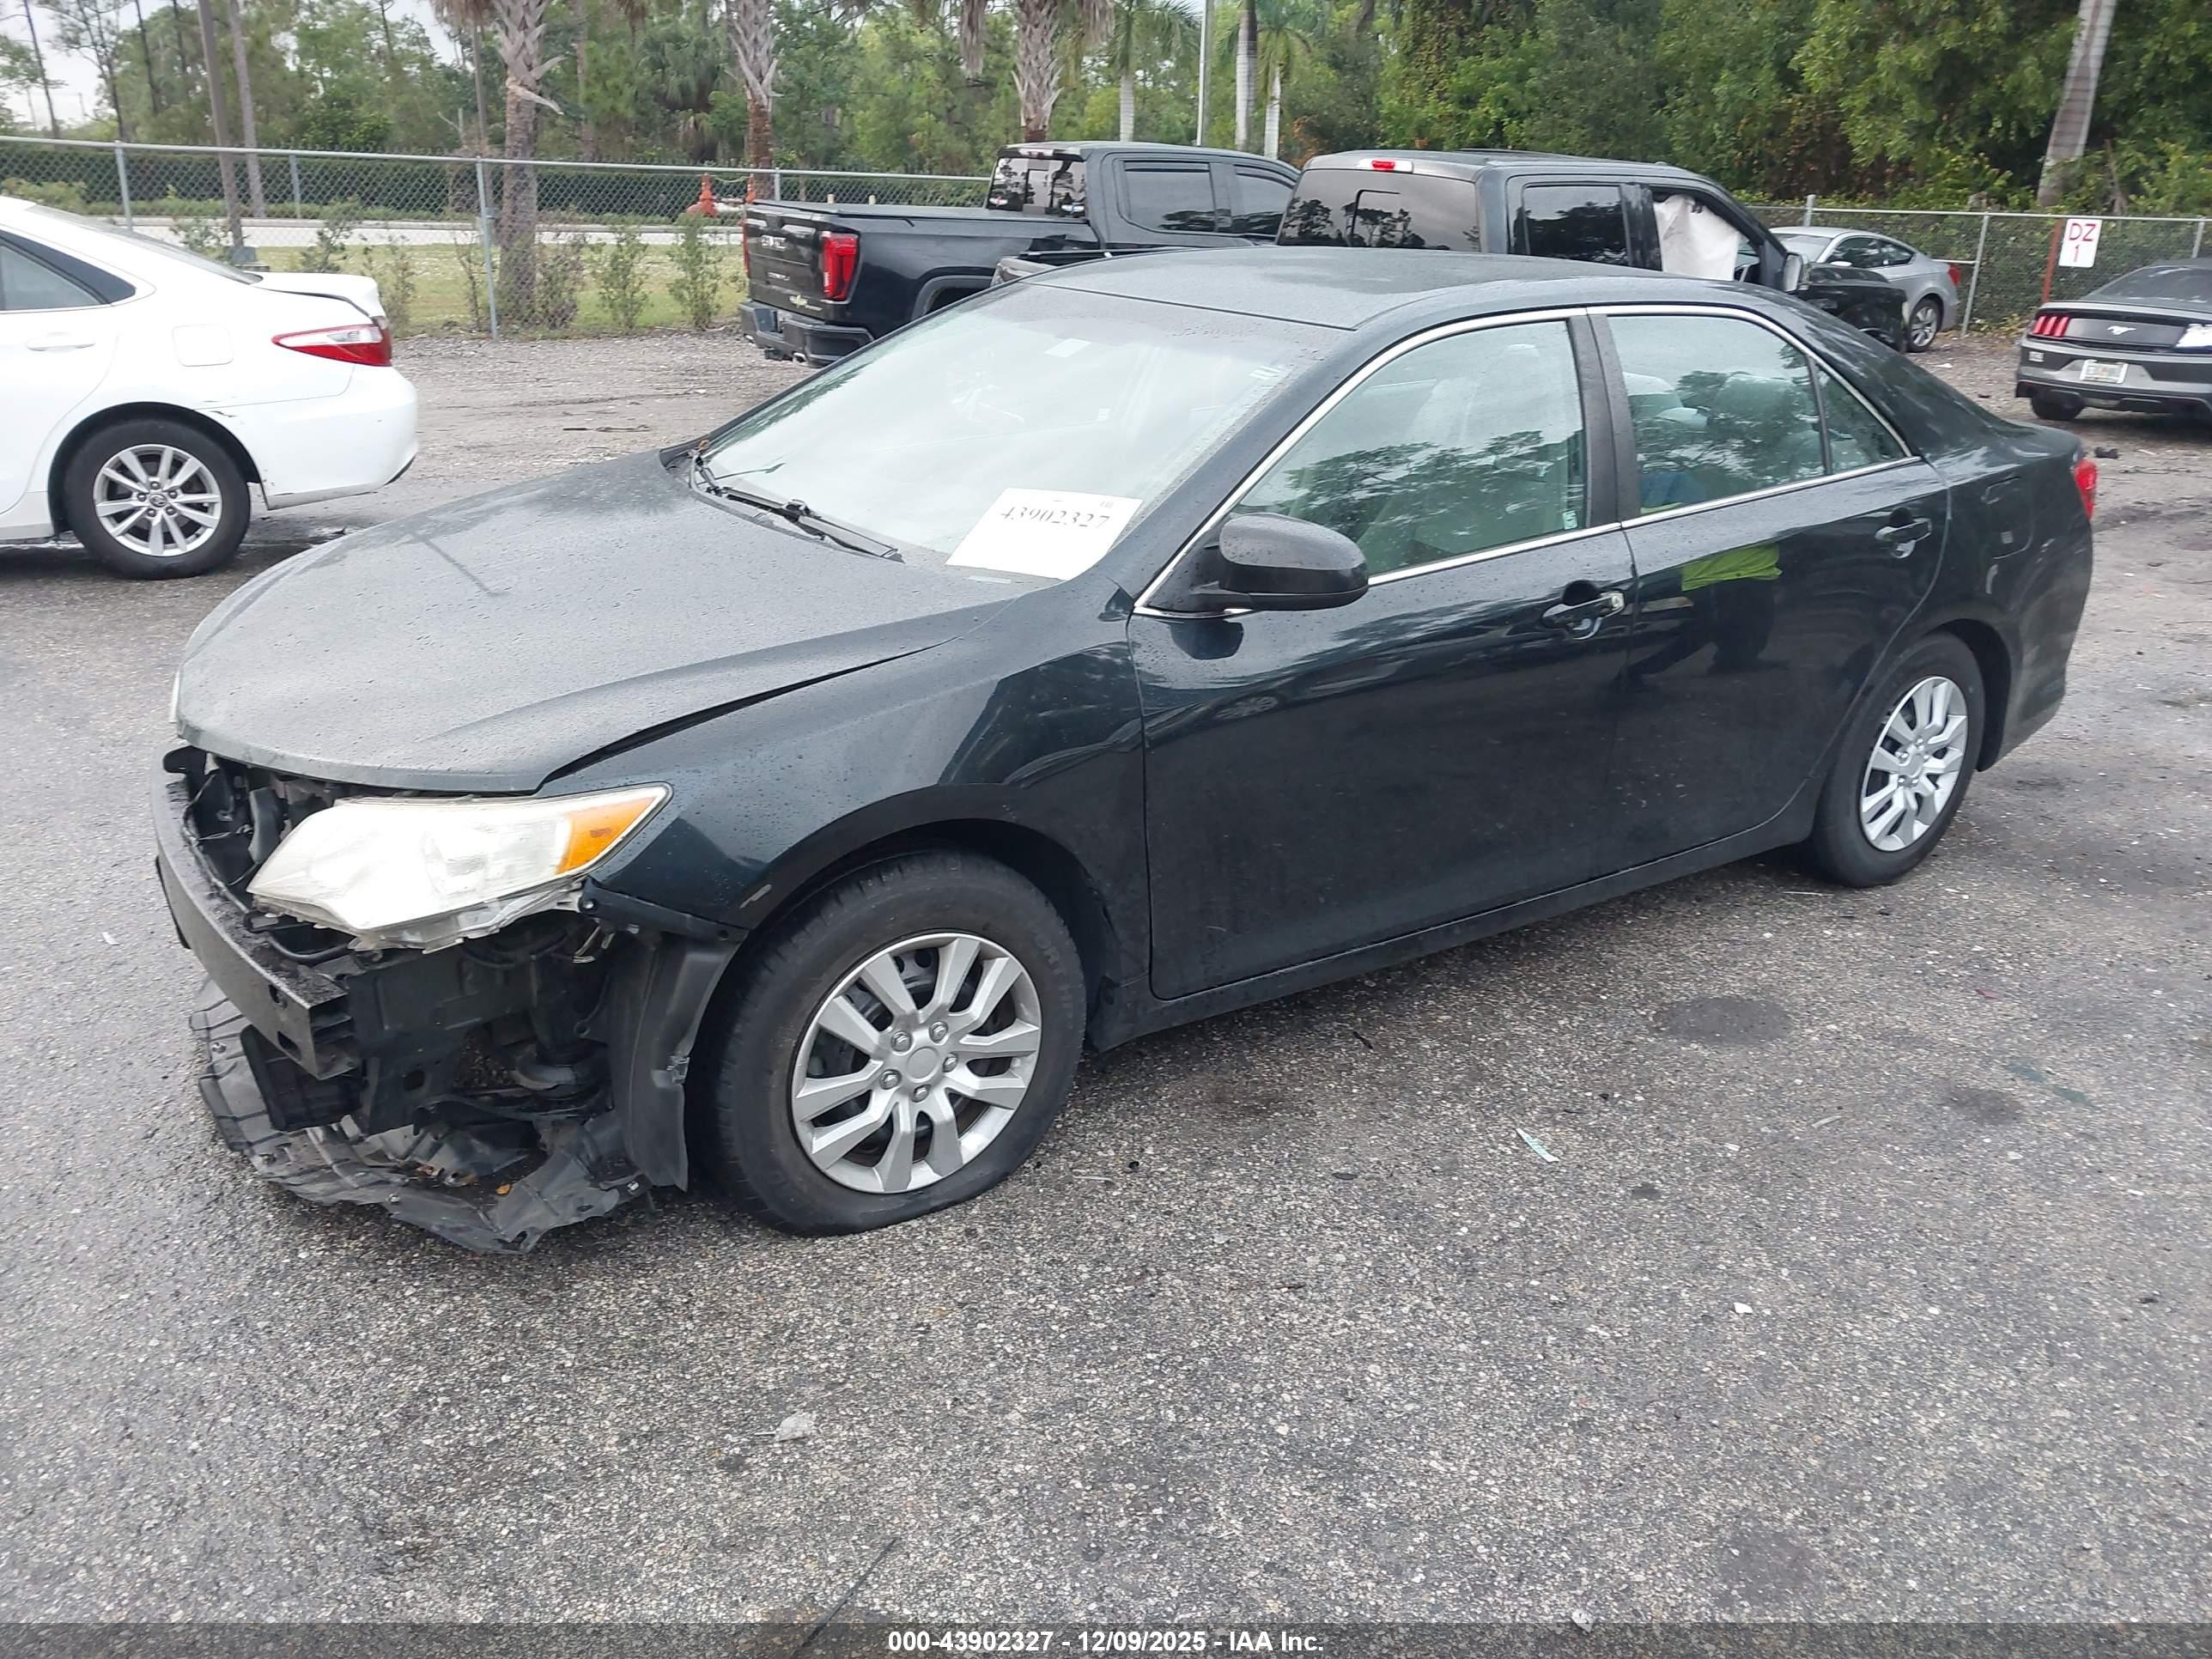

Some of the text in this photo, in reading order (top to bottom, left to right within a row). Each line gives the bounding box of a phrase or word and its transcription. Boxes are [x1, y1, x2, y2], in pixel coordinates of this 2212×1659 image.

[2069, 222, 2097, 241] DZ
[2073, 244, 2081, 263] 1
[1000, 506, 1111, 529] 43902327
